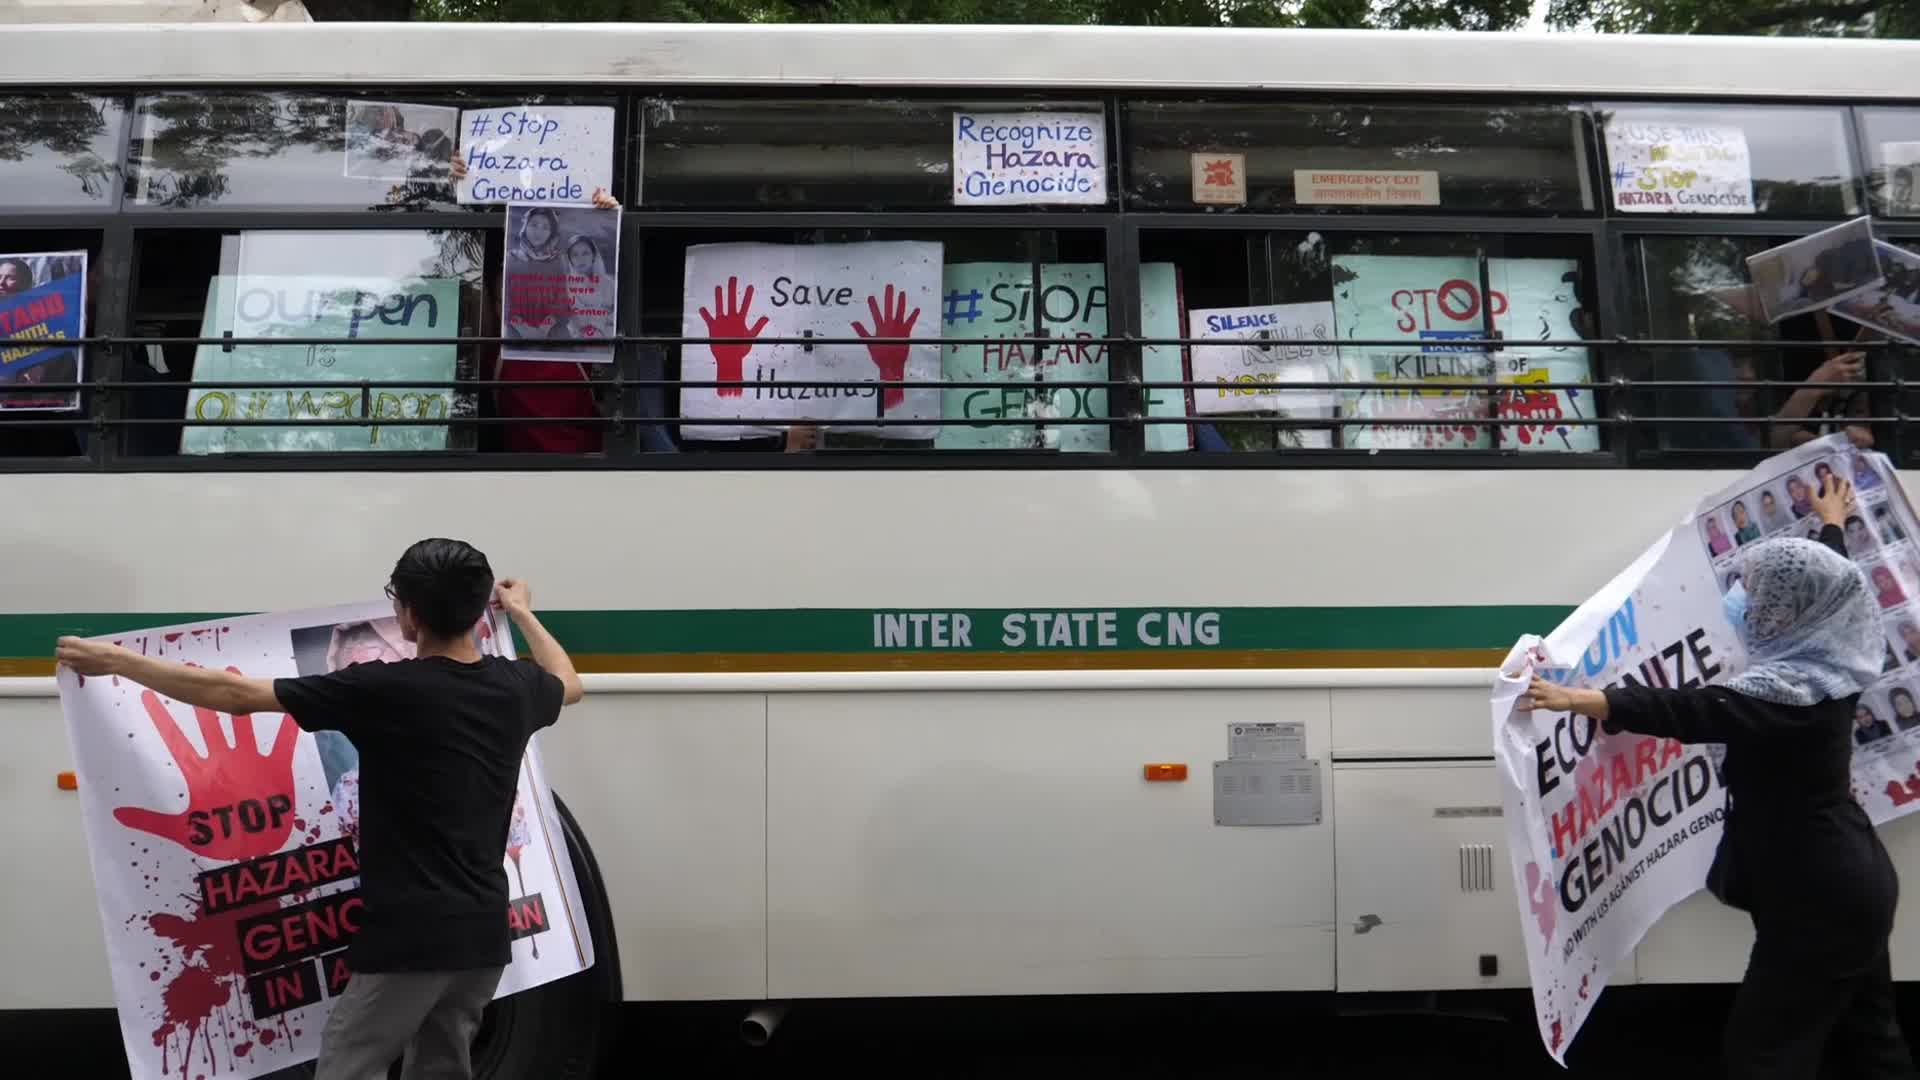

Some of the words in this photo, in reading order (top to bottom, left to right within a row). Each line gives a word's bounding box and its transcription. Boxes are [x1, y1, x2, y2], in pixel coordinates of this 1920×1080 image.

[959, 116, 1092, 148] Recognize
[466, 146, 568, 171] Hazara
[986, 143, 1097, 169] Hazara
[472, 176, 583, 200] Genocide
[966, 169, 1091, 197] Genocide
[1312, 174, 1389, 185] EMERGENCY
[1394, 174, 1421, 185] EXIT
[1618, 191, 1673, 206] HAZARA
[770, 276, 853, 308] Save
[1391, 279, 1509, 338] STOP
[0, 292, 65, 336] TAND
[347, 288, 438, 338] pen
[1206, 312, 1279, 334] SILENCE
[1, 330, 66, 363] HAZAS
[1508, 356, 1528, 373] OF
[285, 390, 449, 447] weapon
[873, 613, 973, 648] INTER
[1001, 612, 1117, 647] STATE
[1136, 611, 1221, 646] CNG
[1551, 737, 1683, 859] HAZARA
[187, 794, 291, 846] STOP
[1646, 828, 1689, 869] HAZARA
[204, 844, 357, 909] HAZARA
[243, 898, 364, 961] GENO
[264, 972, 305, 1009] IN
[331, 959, 351, 989] A
